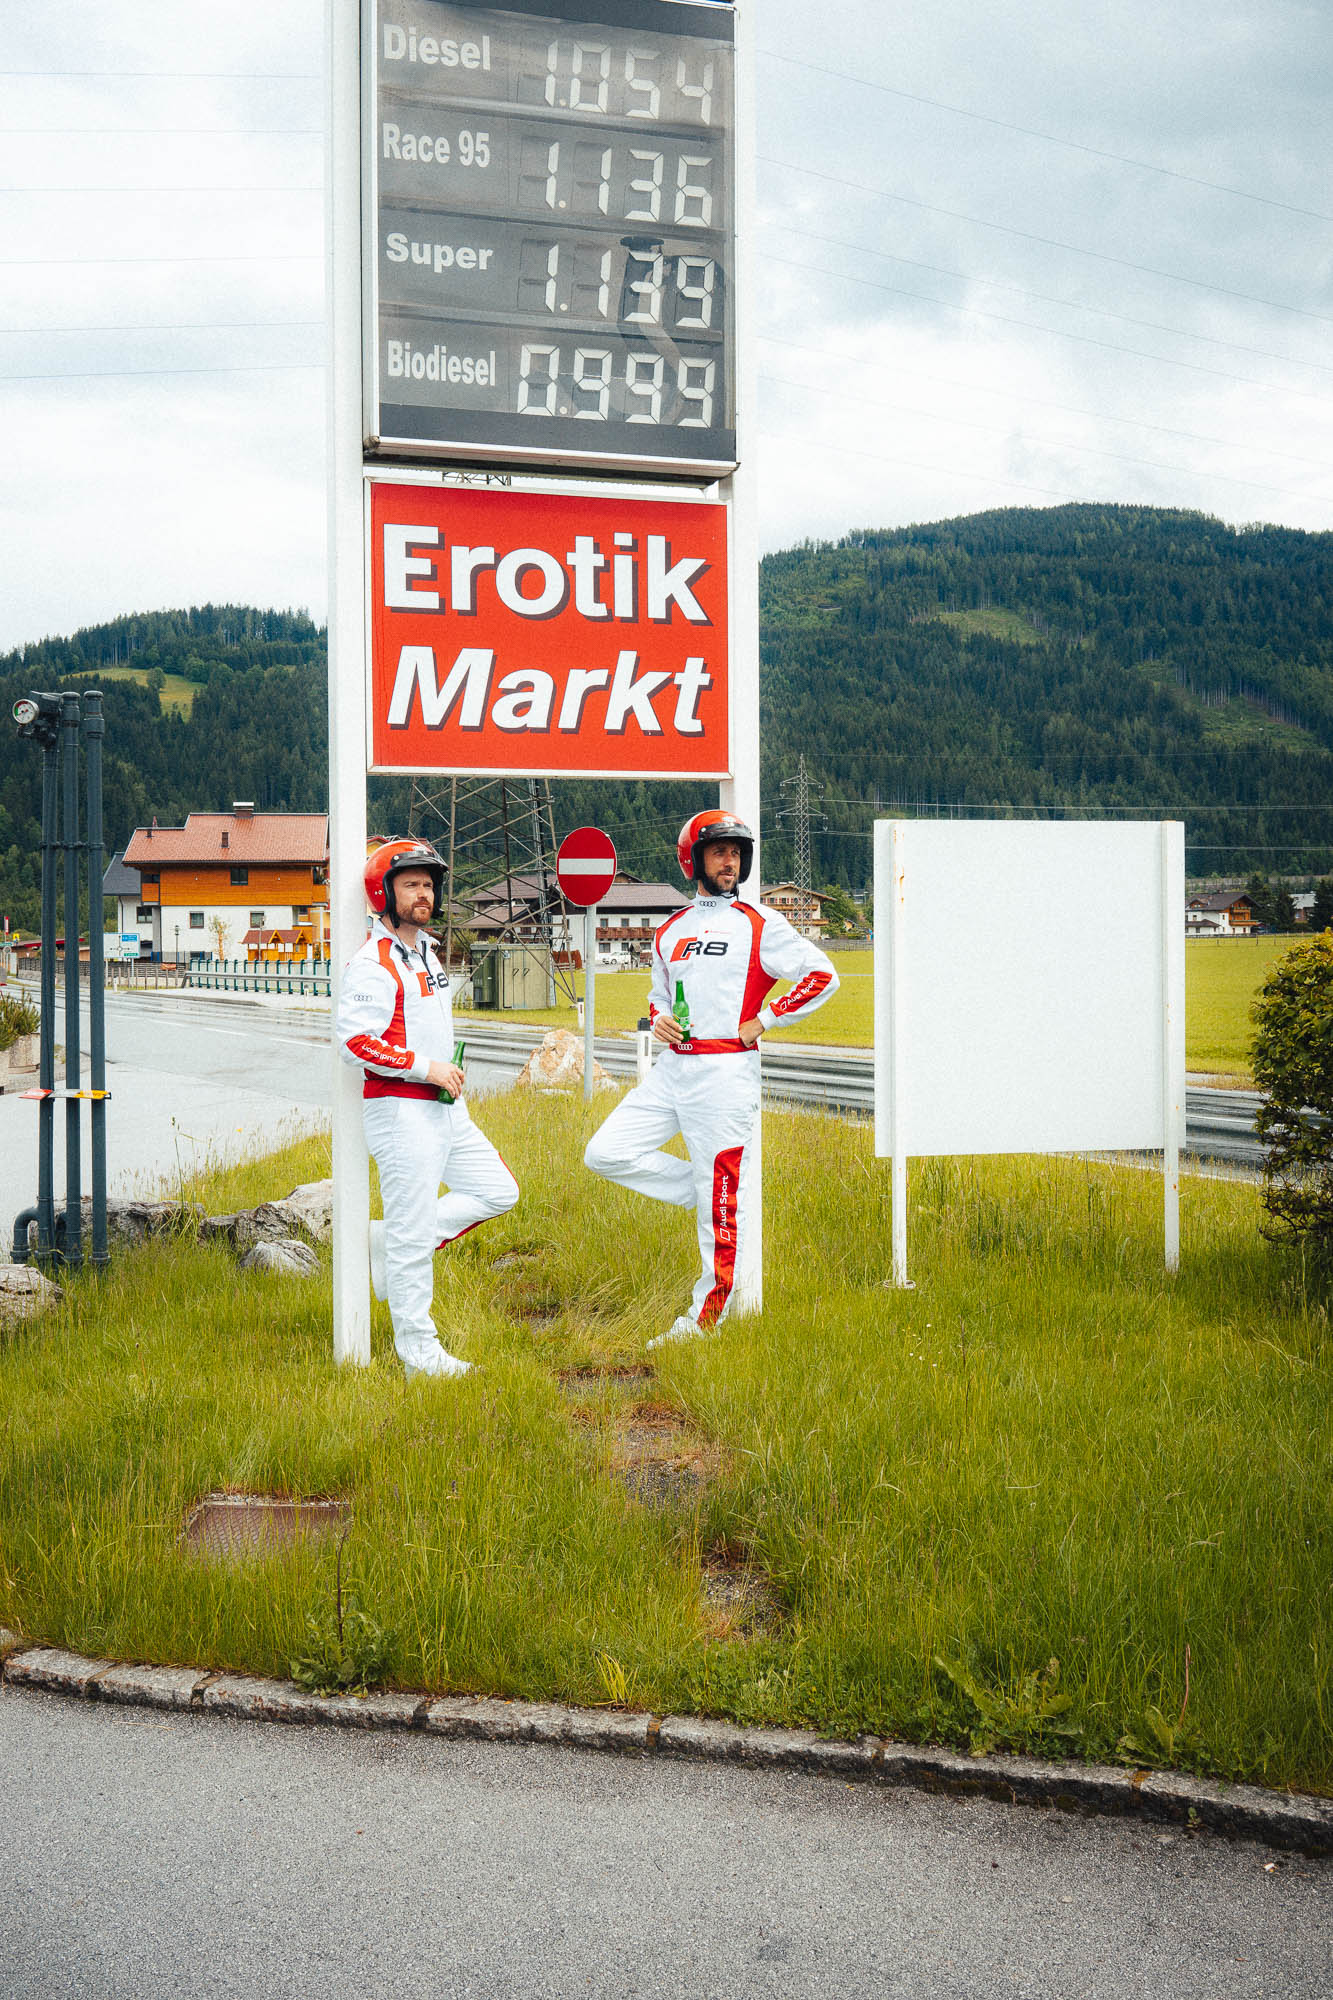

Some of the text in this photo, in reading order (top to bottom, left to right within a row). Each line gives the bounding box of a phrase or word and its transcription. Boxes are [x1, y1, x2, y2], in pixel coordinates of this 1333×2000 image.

[383, 24, 491, 71] Diesel
[544, 39, 714, 126] 1.054
[383, 123, 491, 168] Race 95
[545, 141, 713, 228] 1.136
[386, 232, 494, 273] Super
[545, 243, 715, 329] 1.139
[387, 340, 496, 387] Biodiesel
[517, 343, 716, 429] 0.999
[383, 523, 711, 624] Erotik
[387, 645, 712, 735] Markt
[680, 939, 729, 958] R8
[719, 1175, 729, 1227] Audi Sport
